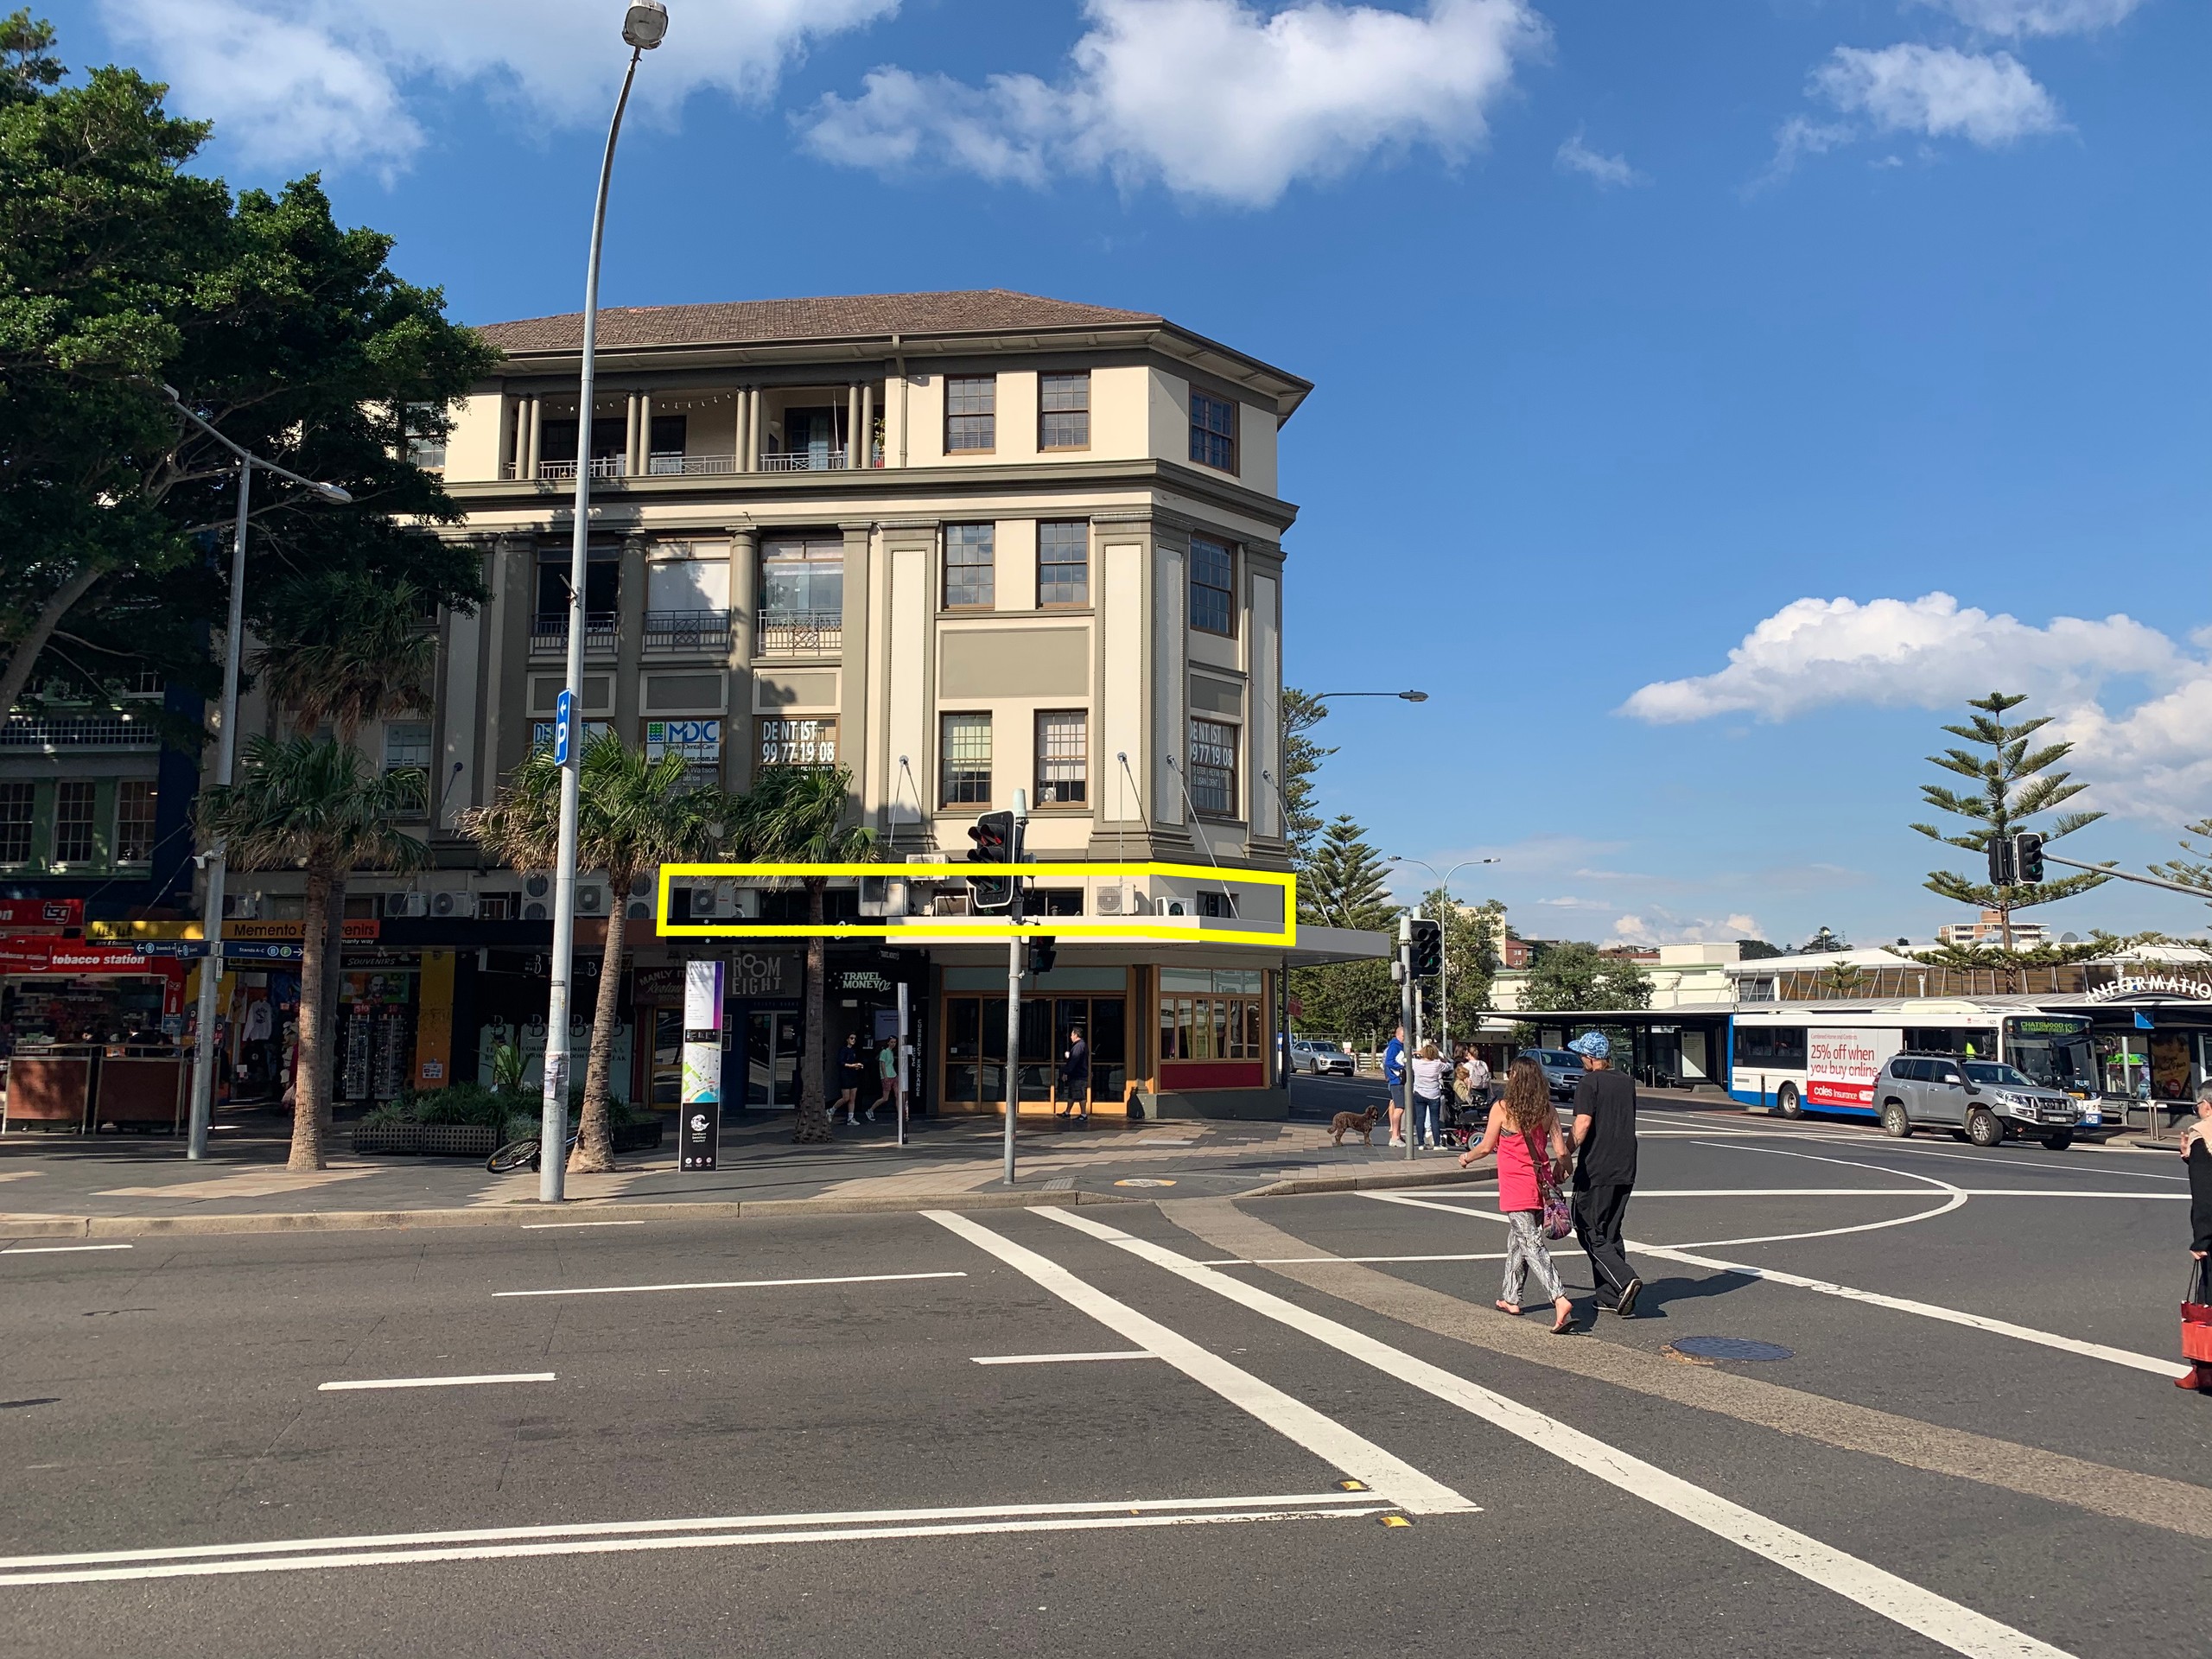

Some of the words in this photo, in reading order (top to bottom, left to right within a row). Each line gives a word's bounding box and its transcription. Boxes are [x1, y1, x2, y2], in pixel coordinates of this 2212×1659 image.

[557, 722, 566, 757] P
[669, 721, 716, 742] MDC
[763, 721, 817, 741] DENTIST
[763, 742, 778, 763] 99
[781, 742, 796, 763] 77
[800, 742, 815, 762] 19
[819, 741, 835, 762] 08
[1211, 746, 1221, 766] 19
[1223, 748, 1233, 768] 08
[234, 924, 297, 937] Memento
[52, 954, 99, 965] tobacco
[104, 954, 145, 964] station
[733, 953, 781, 978] ROOM
[639, 969, 673, 986] MANLY
[843, 971, 881, 981] TRAVEL
[732, 977, 782, 995] EIGHT
[2085, 976, 2212, 1003] INFORMATIO
[2064, 1023, 2079, 1033] 136
[1811, 1044, 1831, 1060] 25%
[1834, 1044, 1847, 1060] off
[1848, 1045, 1874, 1061] when
[1810, 1064, 1827, 1077] you
[1829, 1060, 1847, 1080] buy
[1814, 1085, 1833, 1097] coles
